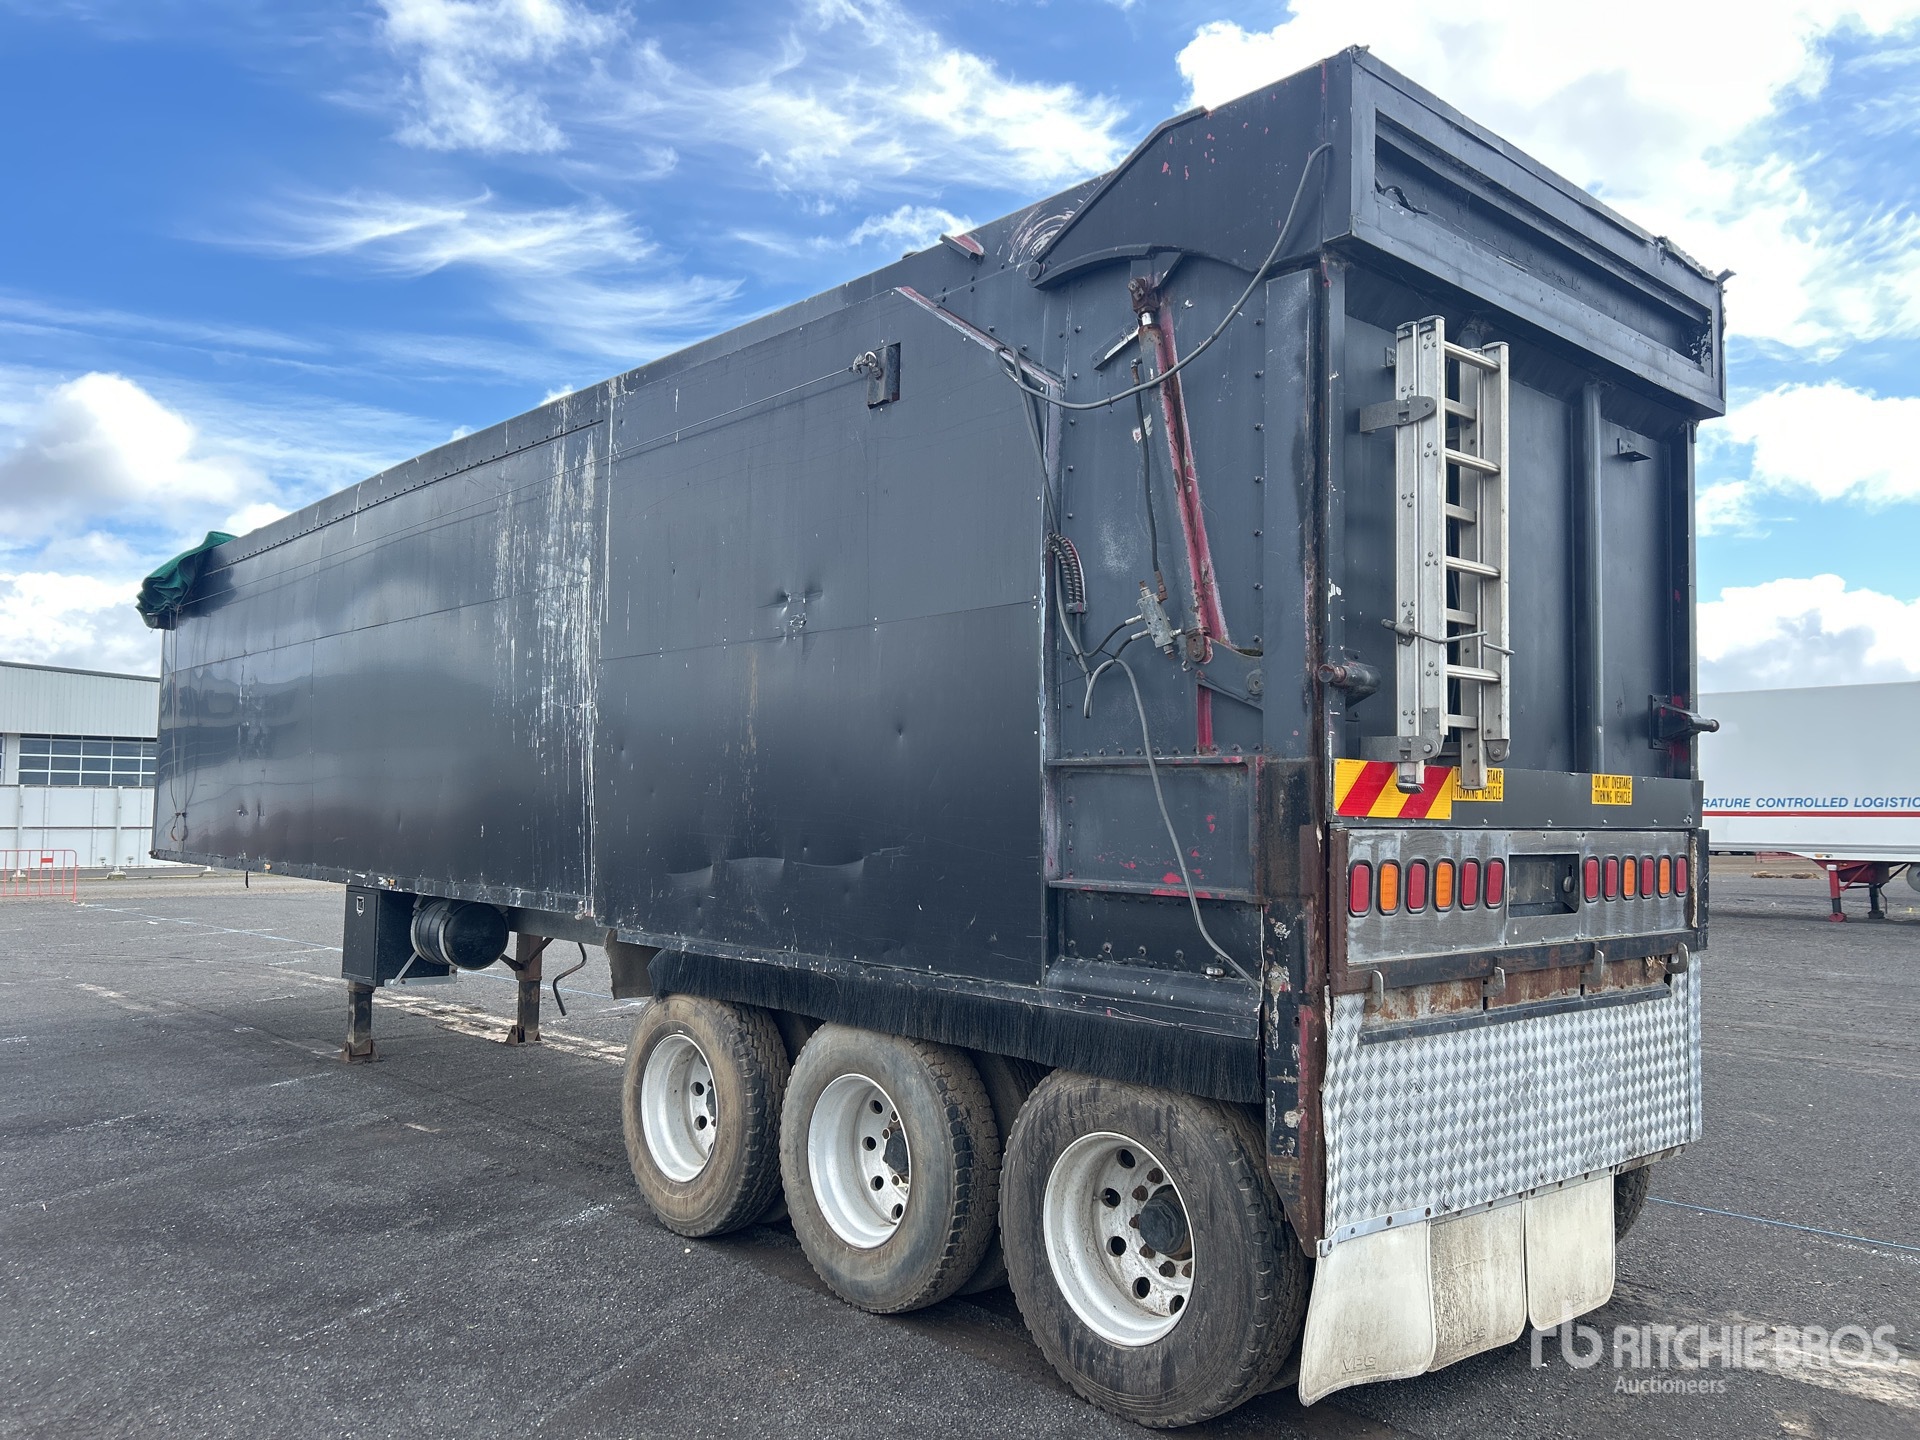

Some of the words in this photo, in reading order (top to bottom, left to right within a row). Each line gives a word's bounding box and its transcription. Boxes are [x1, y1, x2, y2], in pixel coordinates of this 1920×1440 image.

[1594, 775, 1601, 788] DO
[1602, 775, 1610, 789] NOT
[1612, 776, 1631, 790] OVERTAKE
[1482, 785, 1502, 800] VEHICLE
[1594, 790, 1612, 803] TURNING
[1615, 790, 1631, 804] VEHICLE
[1756, 797, 1849, 808] CONTROLLED
